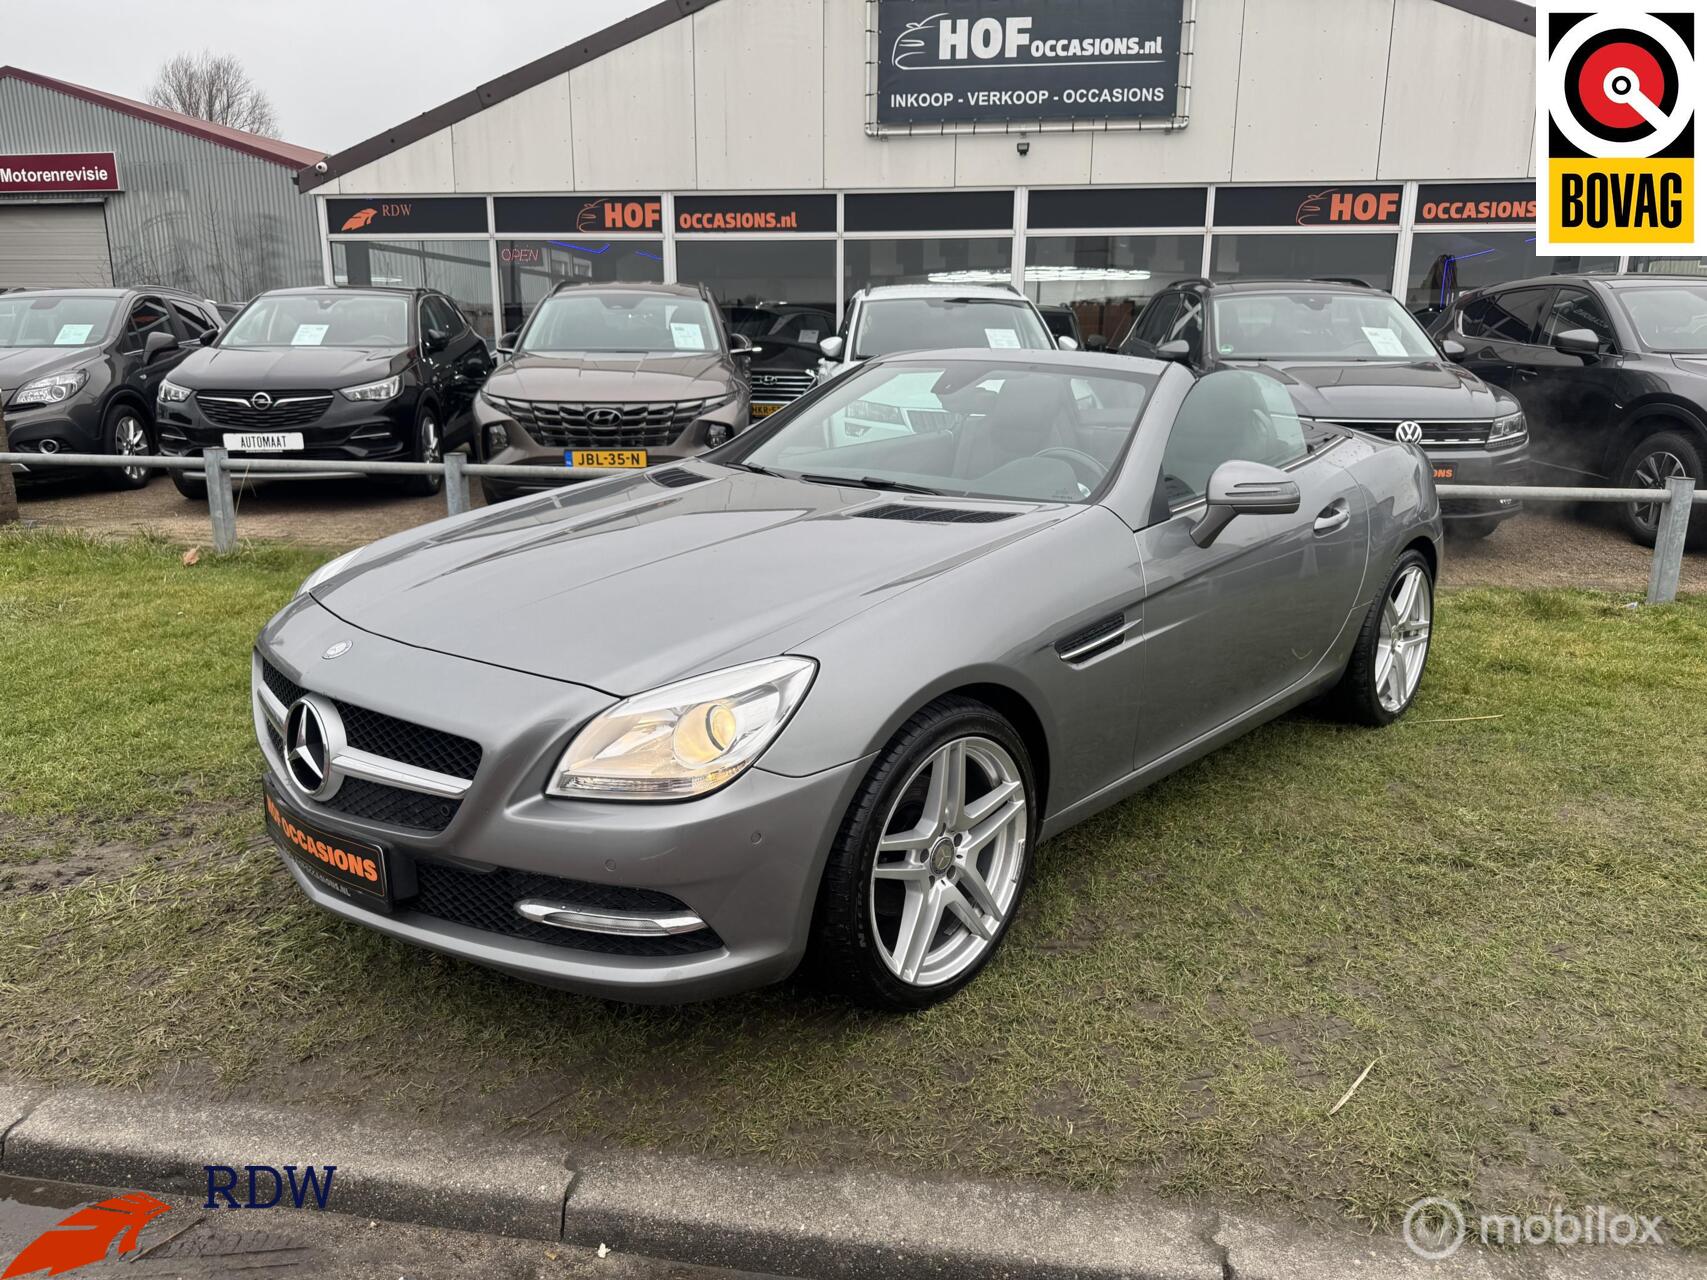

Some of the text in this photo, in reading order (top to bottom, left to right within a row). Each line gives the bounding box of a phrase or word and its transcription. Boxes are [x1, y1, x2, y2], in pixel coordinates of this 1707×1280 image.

[890, 92, 954, 108] INKOOP
[967, 89, 1049, 106] VERKOOP
[1063, 87, 1164, 103] OCCASIONS
[0, 166, 108, 183] Motorenrevisie
[382, 204, 412, 216] RDW
[1329, 192, 1537, 221] HOF OCCASIONS
[604, 202, 797, 229] HOF OCCASIONS.nl
[501, 248, 539, 262] OPEN
[241, 436, 286, 448] AUTOMAAT
[578, 453, 640, 466] JBL-35-N
[281, 817, 378, 882] OCCASIONS
